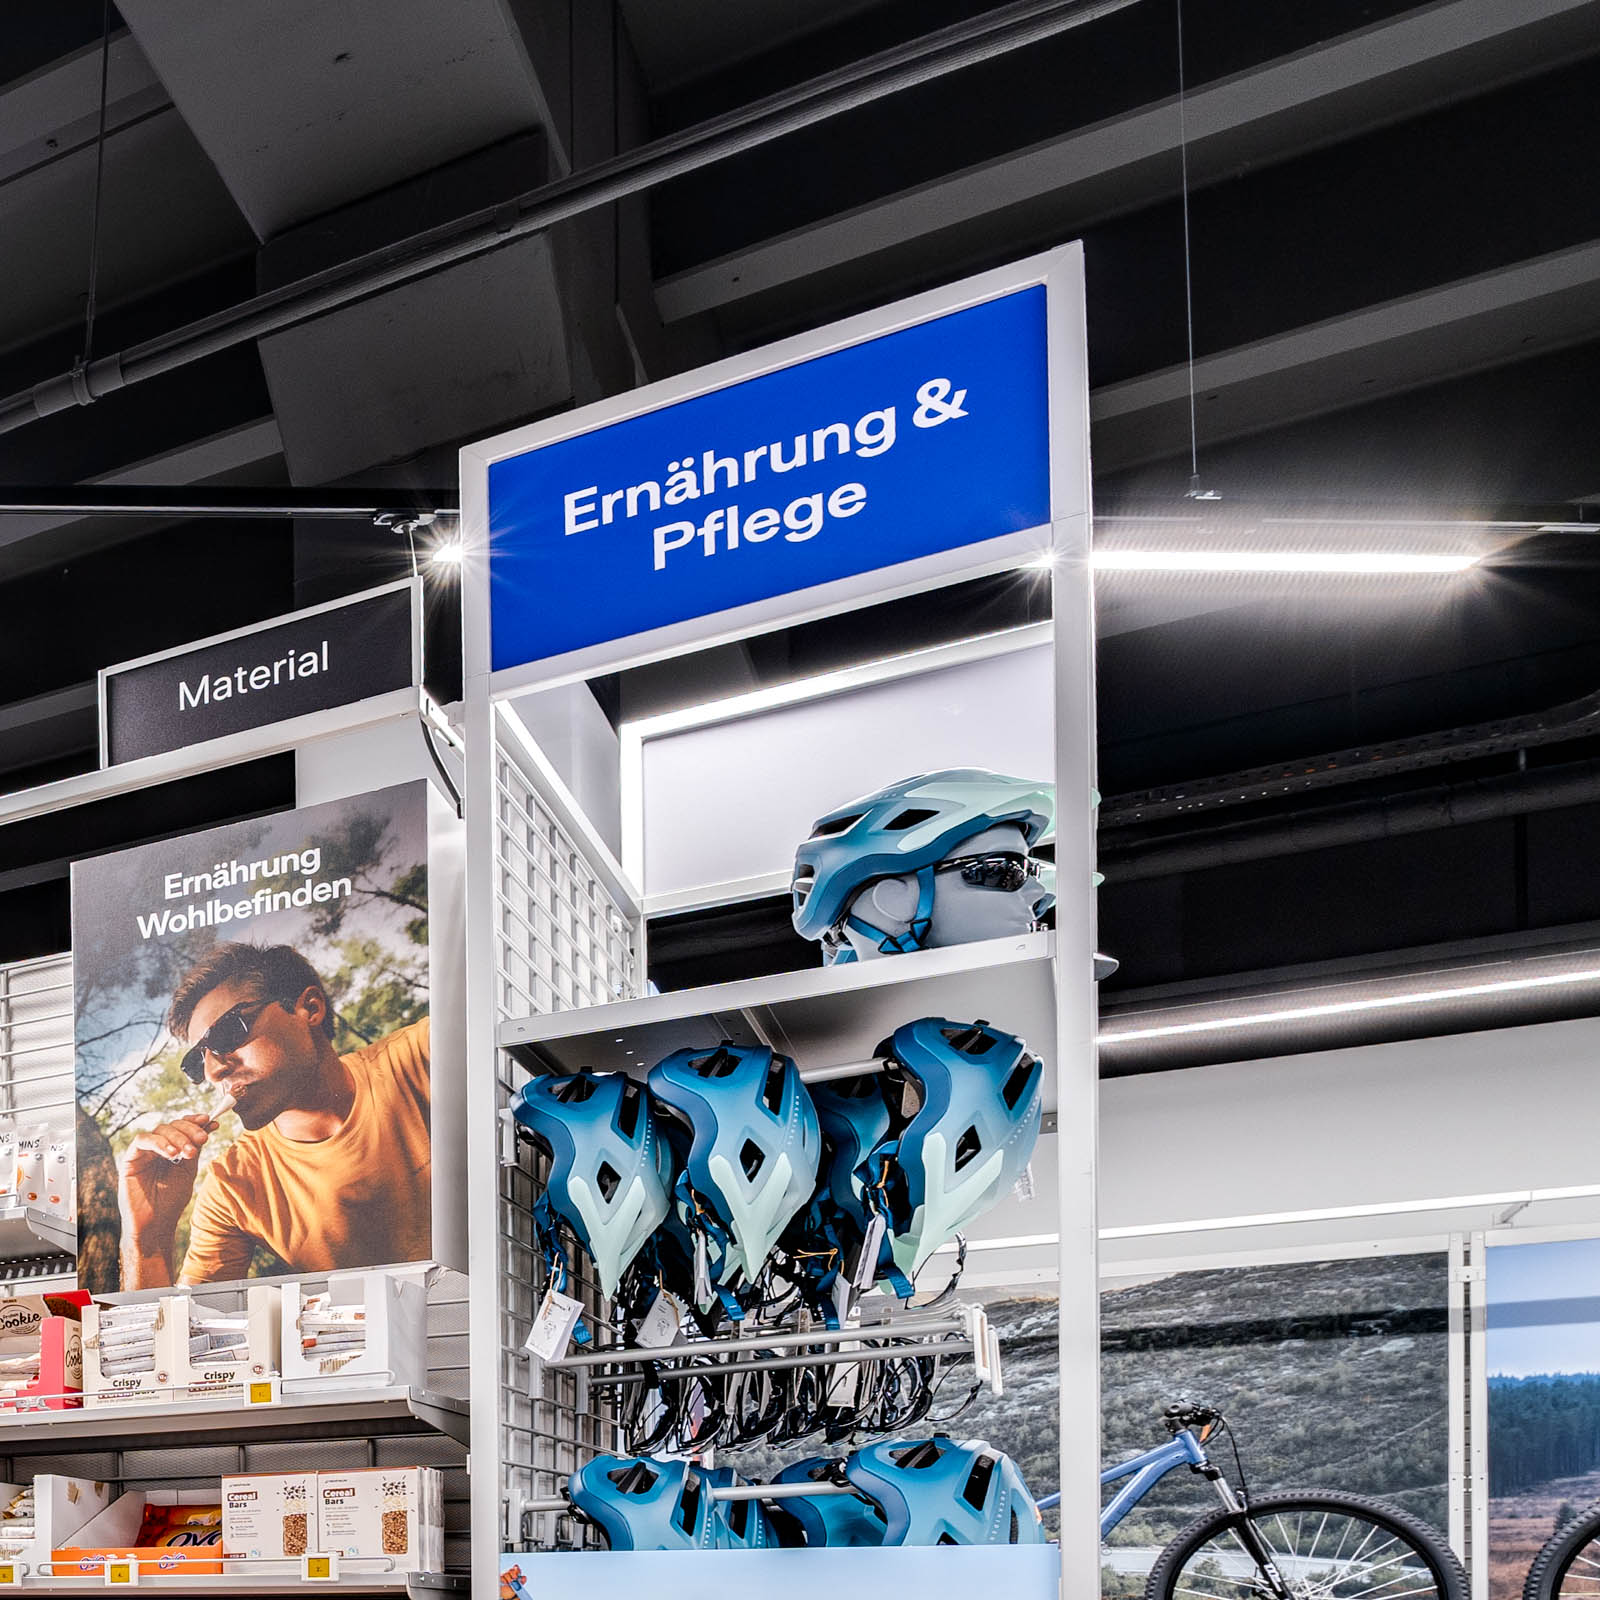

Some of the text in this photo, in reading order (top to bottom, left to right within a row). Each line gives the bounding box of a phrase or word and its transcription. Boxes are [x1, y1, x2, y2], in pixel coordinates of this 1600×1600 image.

[563, 377, 968, 535] Ernährung &
[652, 475, 869, 571] Pflege
[177, 640, 331, 712] Material
[163, 845, 322, 903] Ernährung
[136, 872, 353, 941] Wohlbefinden
[112, 1377, 141, 1388] Crispy
[204, 1370, 236, 1382] Crispy
[324, 1489, 353, 1497] Cereal
